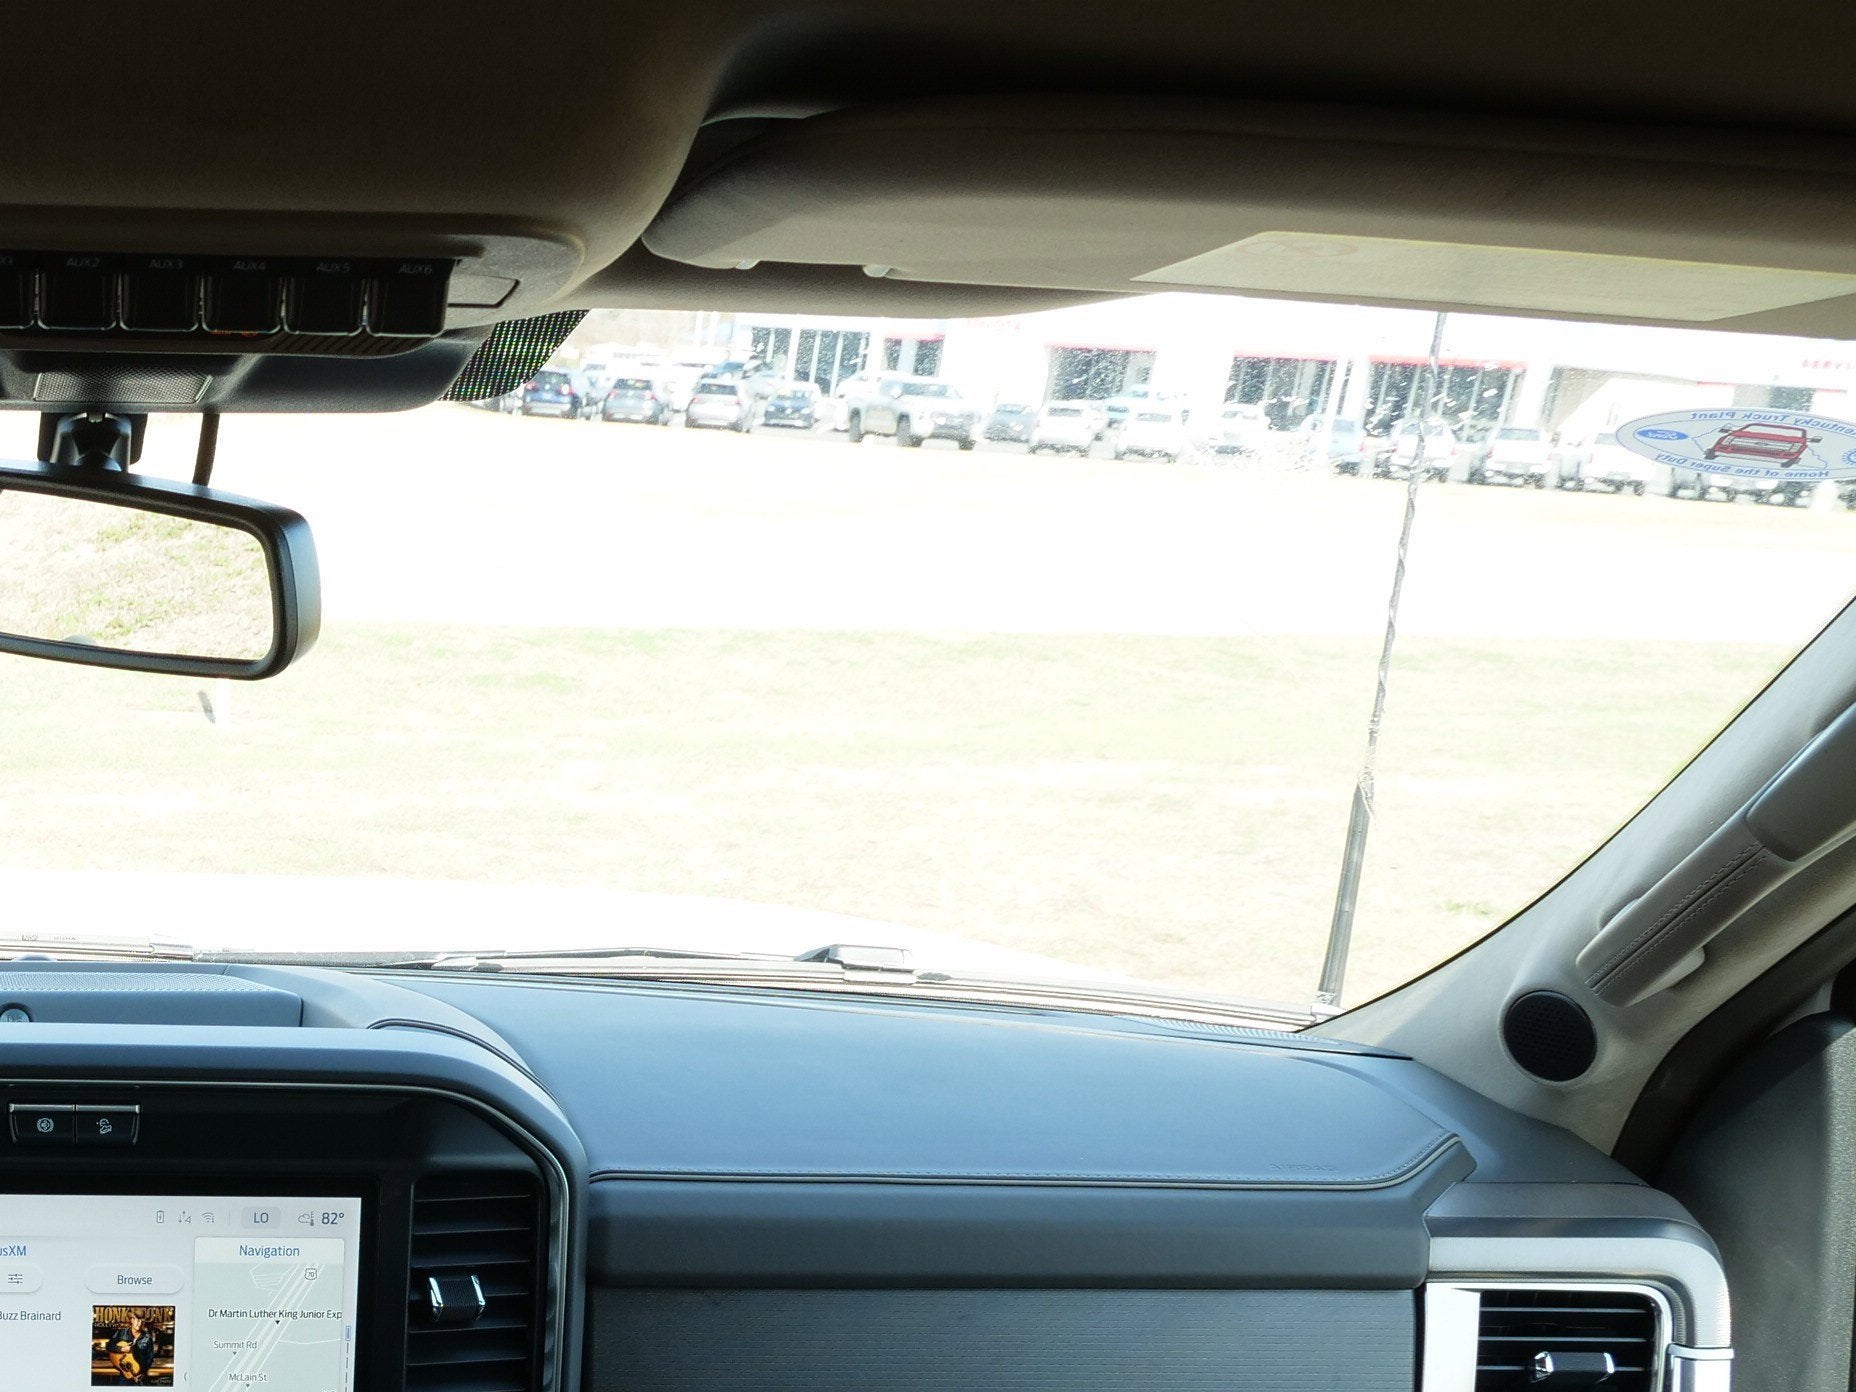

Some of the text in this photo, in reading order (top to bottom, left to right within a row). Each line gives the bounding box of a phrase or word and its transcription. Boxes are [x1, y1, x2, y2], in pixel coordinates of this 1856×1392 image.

[253, 1213, 270, 1224] LO
[321, 1211, 345, 1226] 82°
[239, 1245, 300, 1258] Navigation
[116, 1274, 152, 1286] Browse
[20, 1311, 61, 1321] Brainard
[208, 1309, 218, 1318] Dr
[220, 1310, 247, 1318] Martin
[249, 1310, 277, 1318] Luther
[279, 1310, 297, 1319] King
[300, 1310, 325, 1318] Junior
[229, 1373, 257, 1381] McLain
